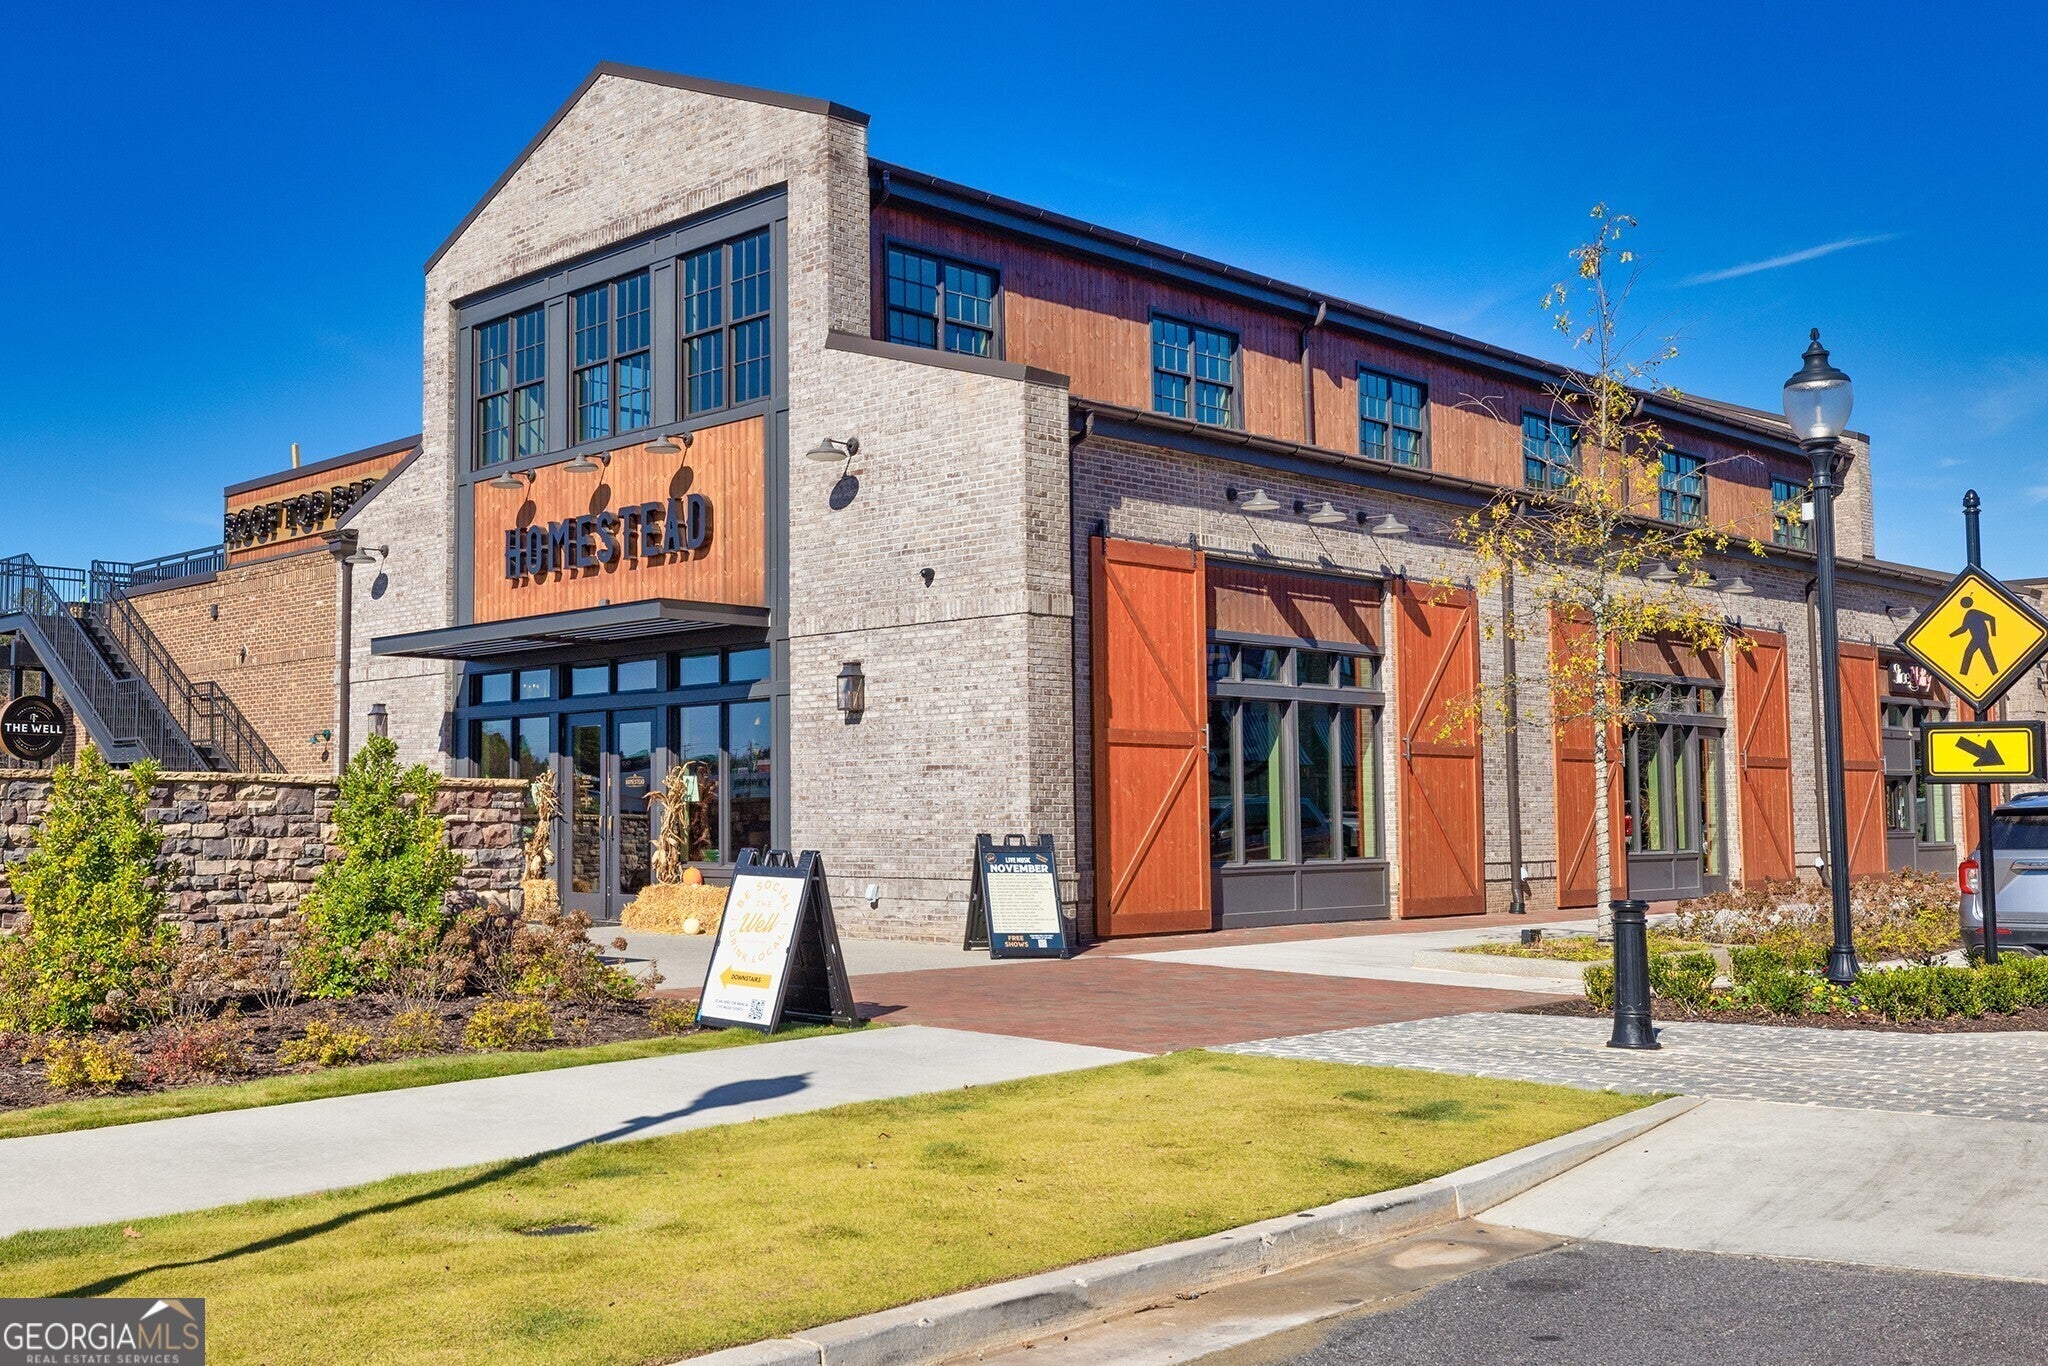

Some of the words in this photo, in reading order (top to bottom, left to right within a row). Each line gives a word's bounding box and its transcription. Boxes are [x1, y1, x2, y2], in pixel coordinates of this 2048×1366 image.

[504, 493, 712, 580] HOMESTEAD
[5, 723, 28, 733] THE
[31, 724, 63, 734] WELL
[990, 864, 1049, 873] NOVEMBER
[737, 889, 751, 909] BE
[757, 880, 791, 911] SOCIAL
[756, 900, 772, 908] THE
[739, 912, 780, 933] Well
[729, 929, 748, 962] DRINK
[751, 933, 784, 963] LOCAL
[731, 974, 762, 983] DOWNSTAIRS
